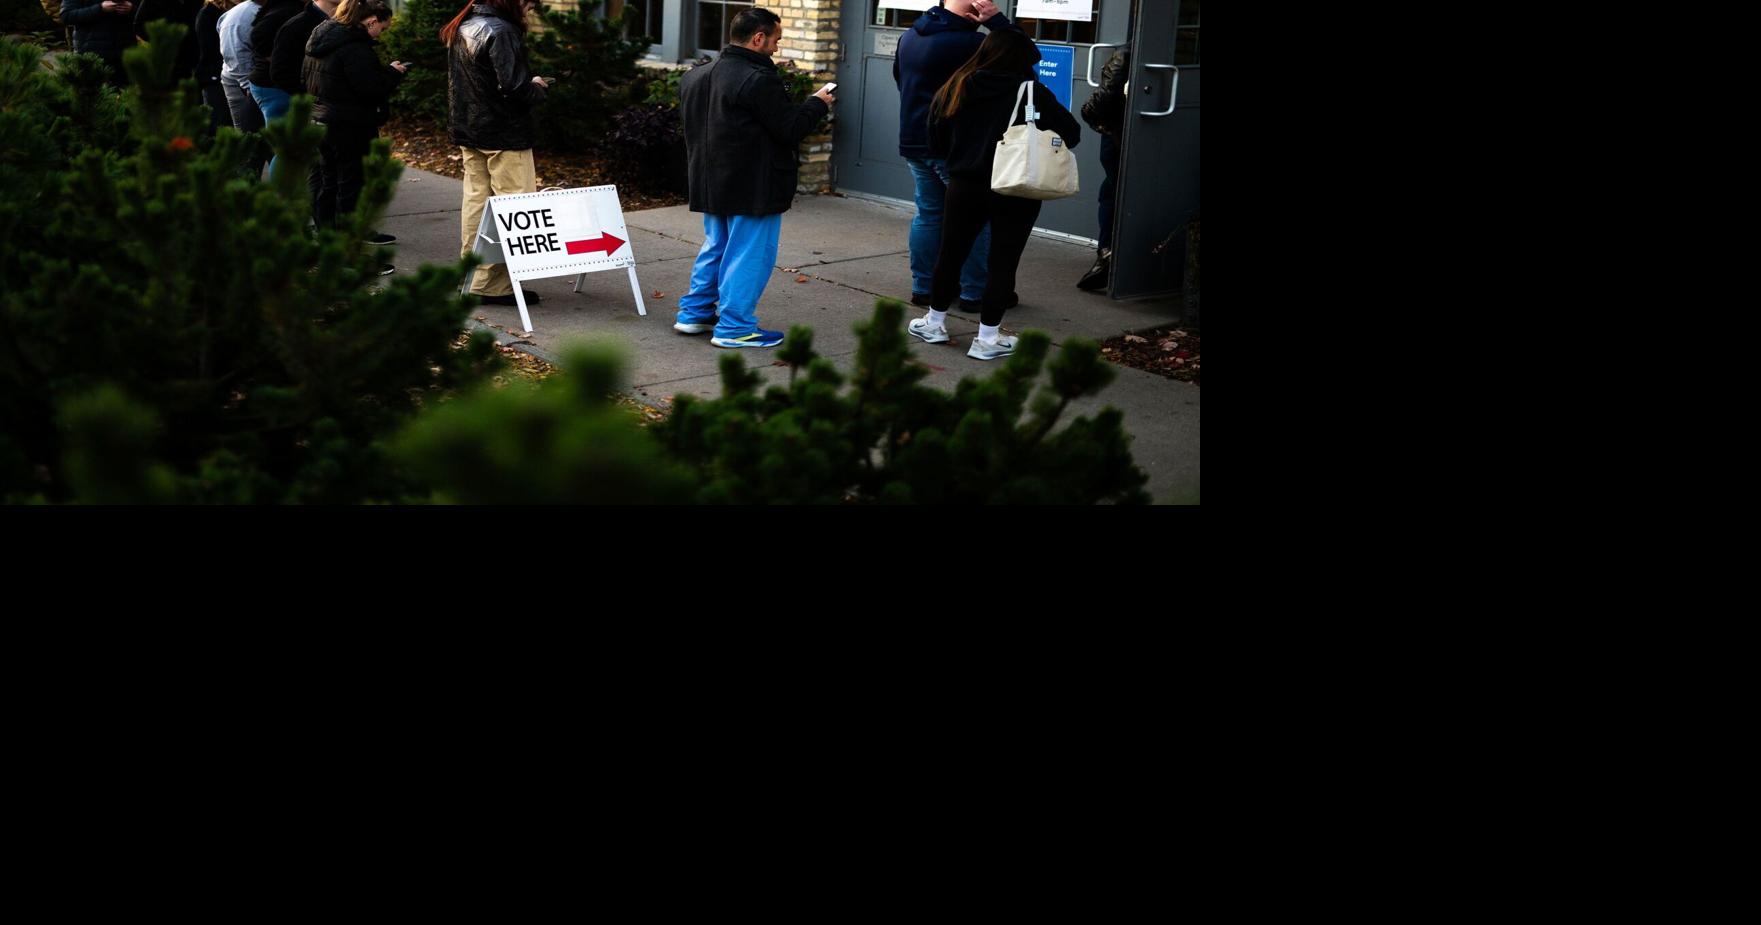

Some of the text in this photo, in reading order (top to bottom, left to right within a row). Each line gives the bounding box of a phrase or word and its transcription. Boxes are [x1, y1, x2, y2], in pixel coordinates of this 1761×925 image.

[1039, 69, 1056, 77] Here
[498, 208, 555, 231] VOTE
[506, 232, 561, 256] HERE
